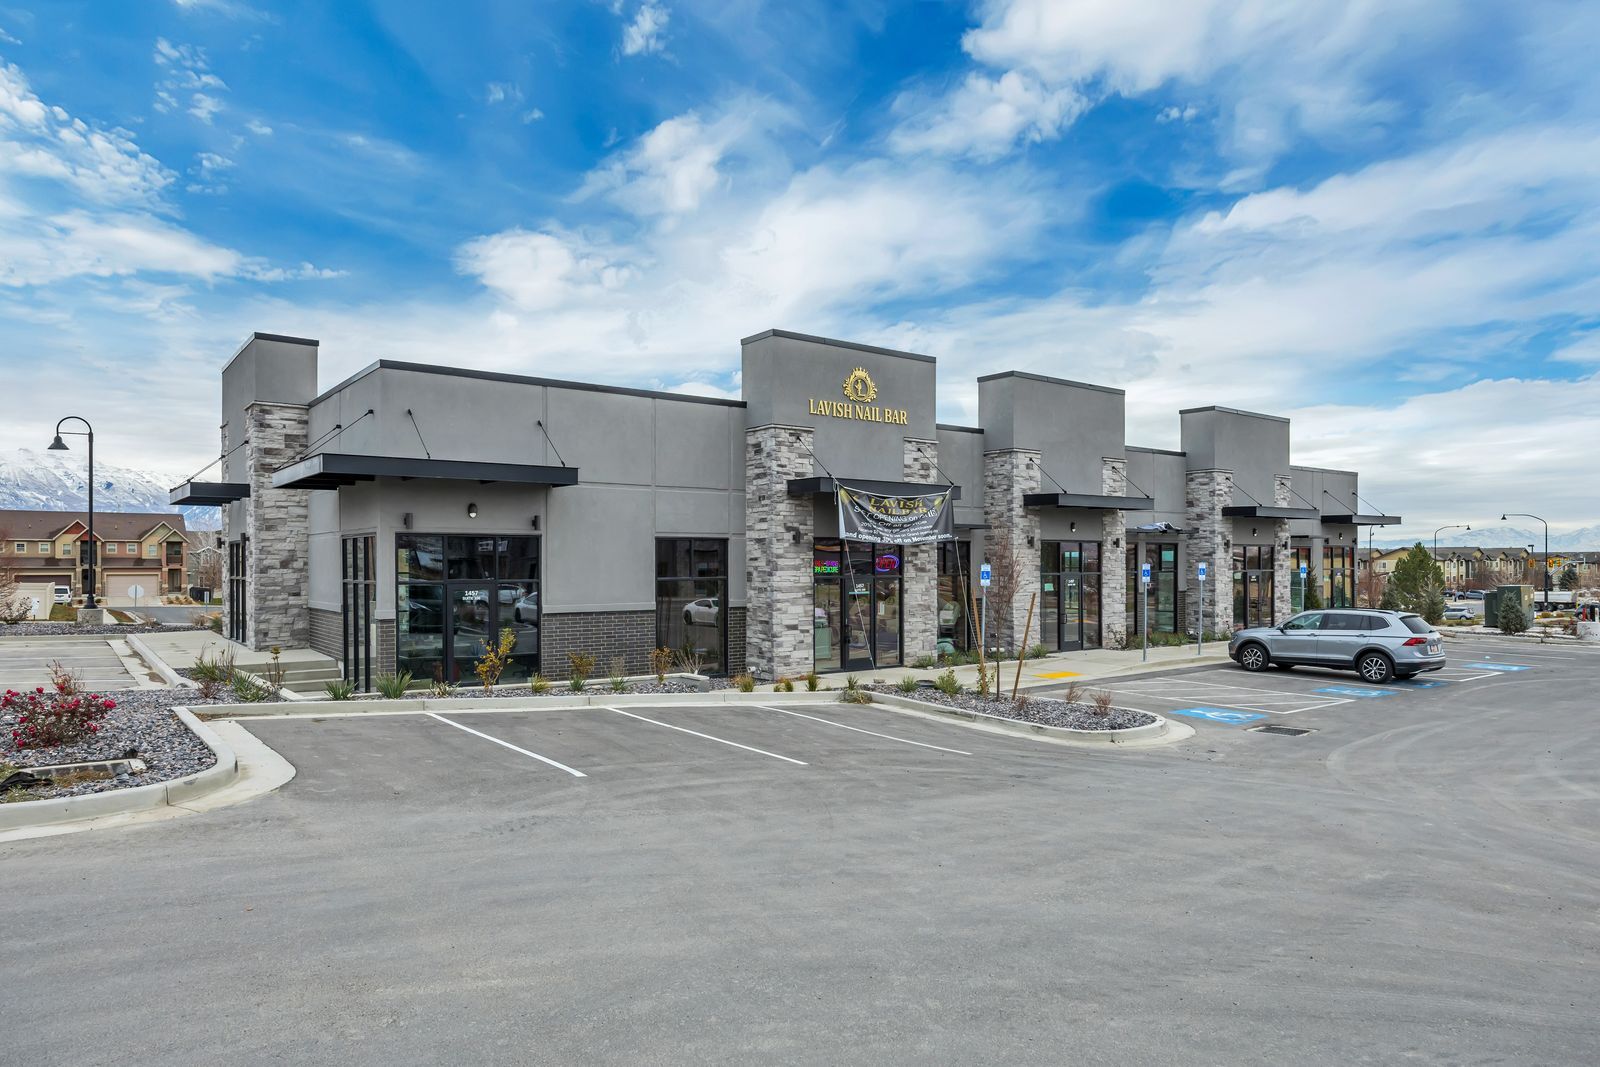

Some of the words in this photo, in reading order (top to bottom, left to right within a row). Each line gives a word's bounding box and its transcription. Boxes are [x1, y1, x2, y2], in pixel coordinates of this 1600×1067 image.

[809, 398, 852, 419] LAVISH
[855, 404, 882, 422] NAIL
[884, 408, 908, 425] BAR
[870, 498, 923, 508] LAVISH
[869, 505, 900, 514] NAIL
[873, 513, 907, 522] OPENING
[858, 533, 881, 543] opening
